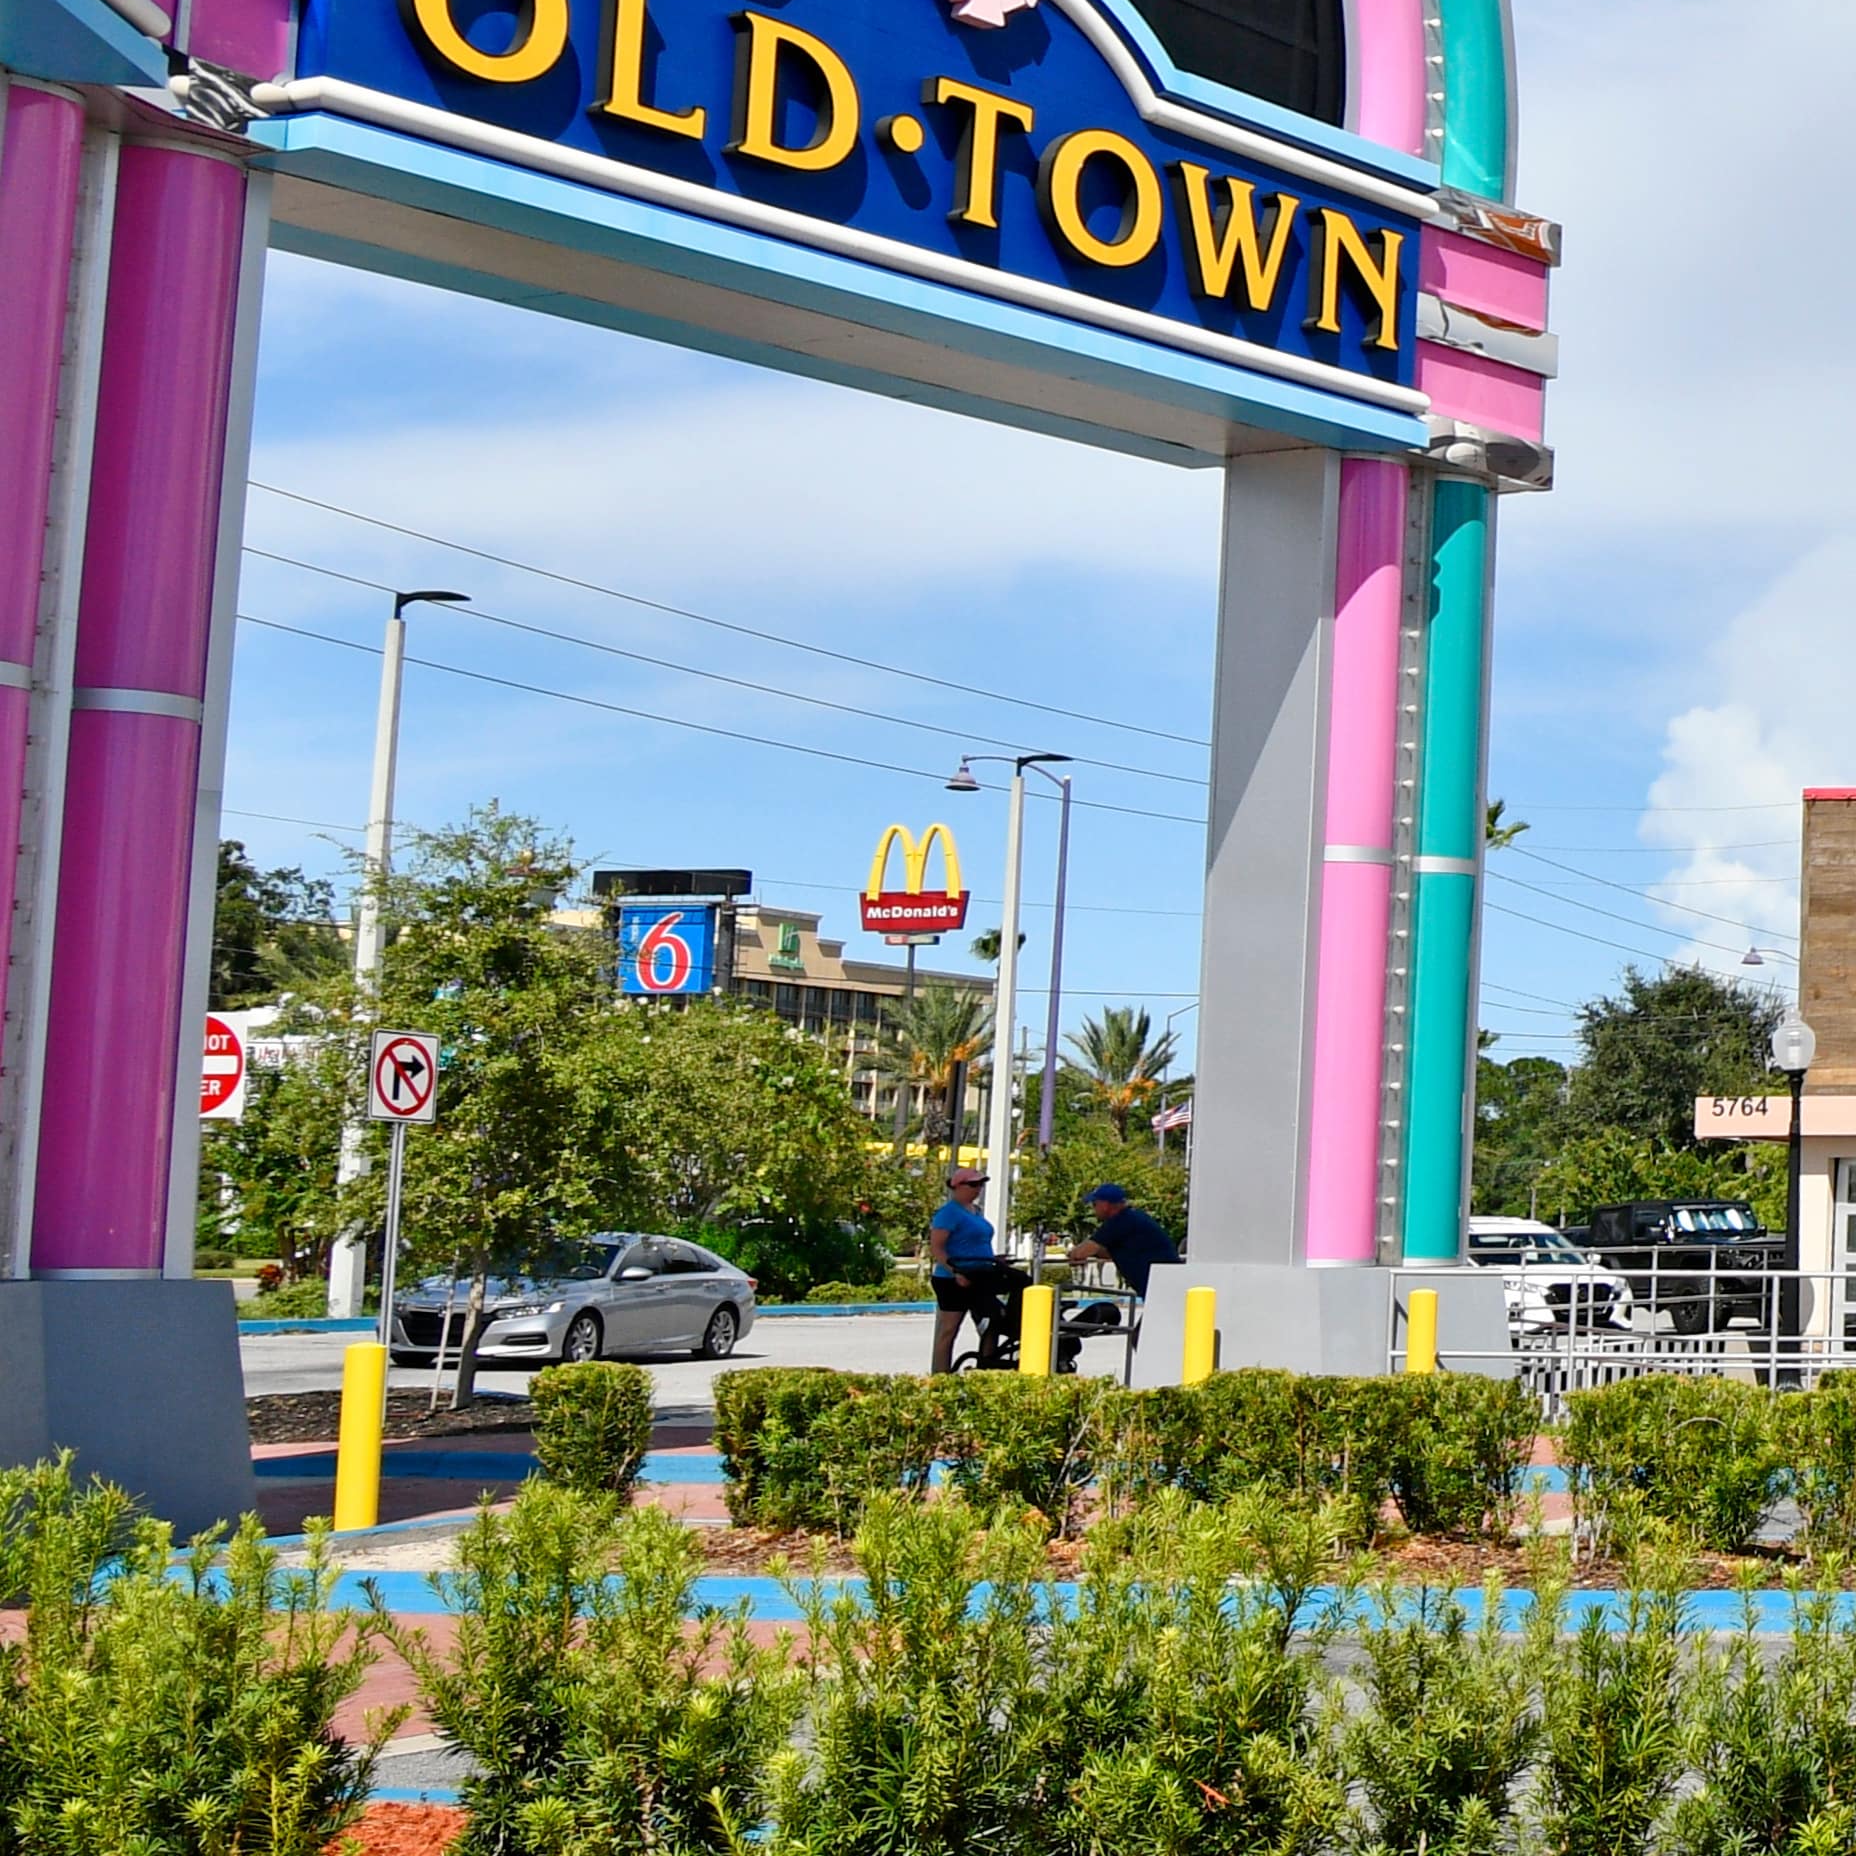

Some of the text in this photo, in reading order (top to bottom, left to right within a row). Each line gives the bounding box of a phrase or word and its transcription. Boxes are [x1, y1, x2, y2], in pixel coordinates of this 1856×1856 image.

[866, 905, 959, 919] McDonald's
[636, 911, 691, 992] 6
[1711, 1096, 1768, 1117] 5764
